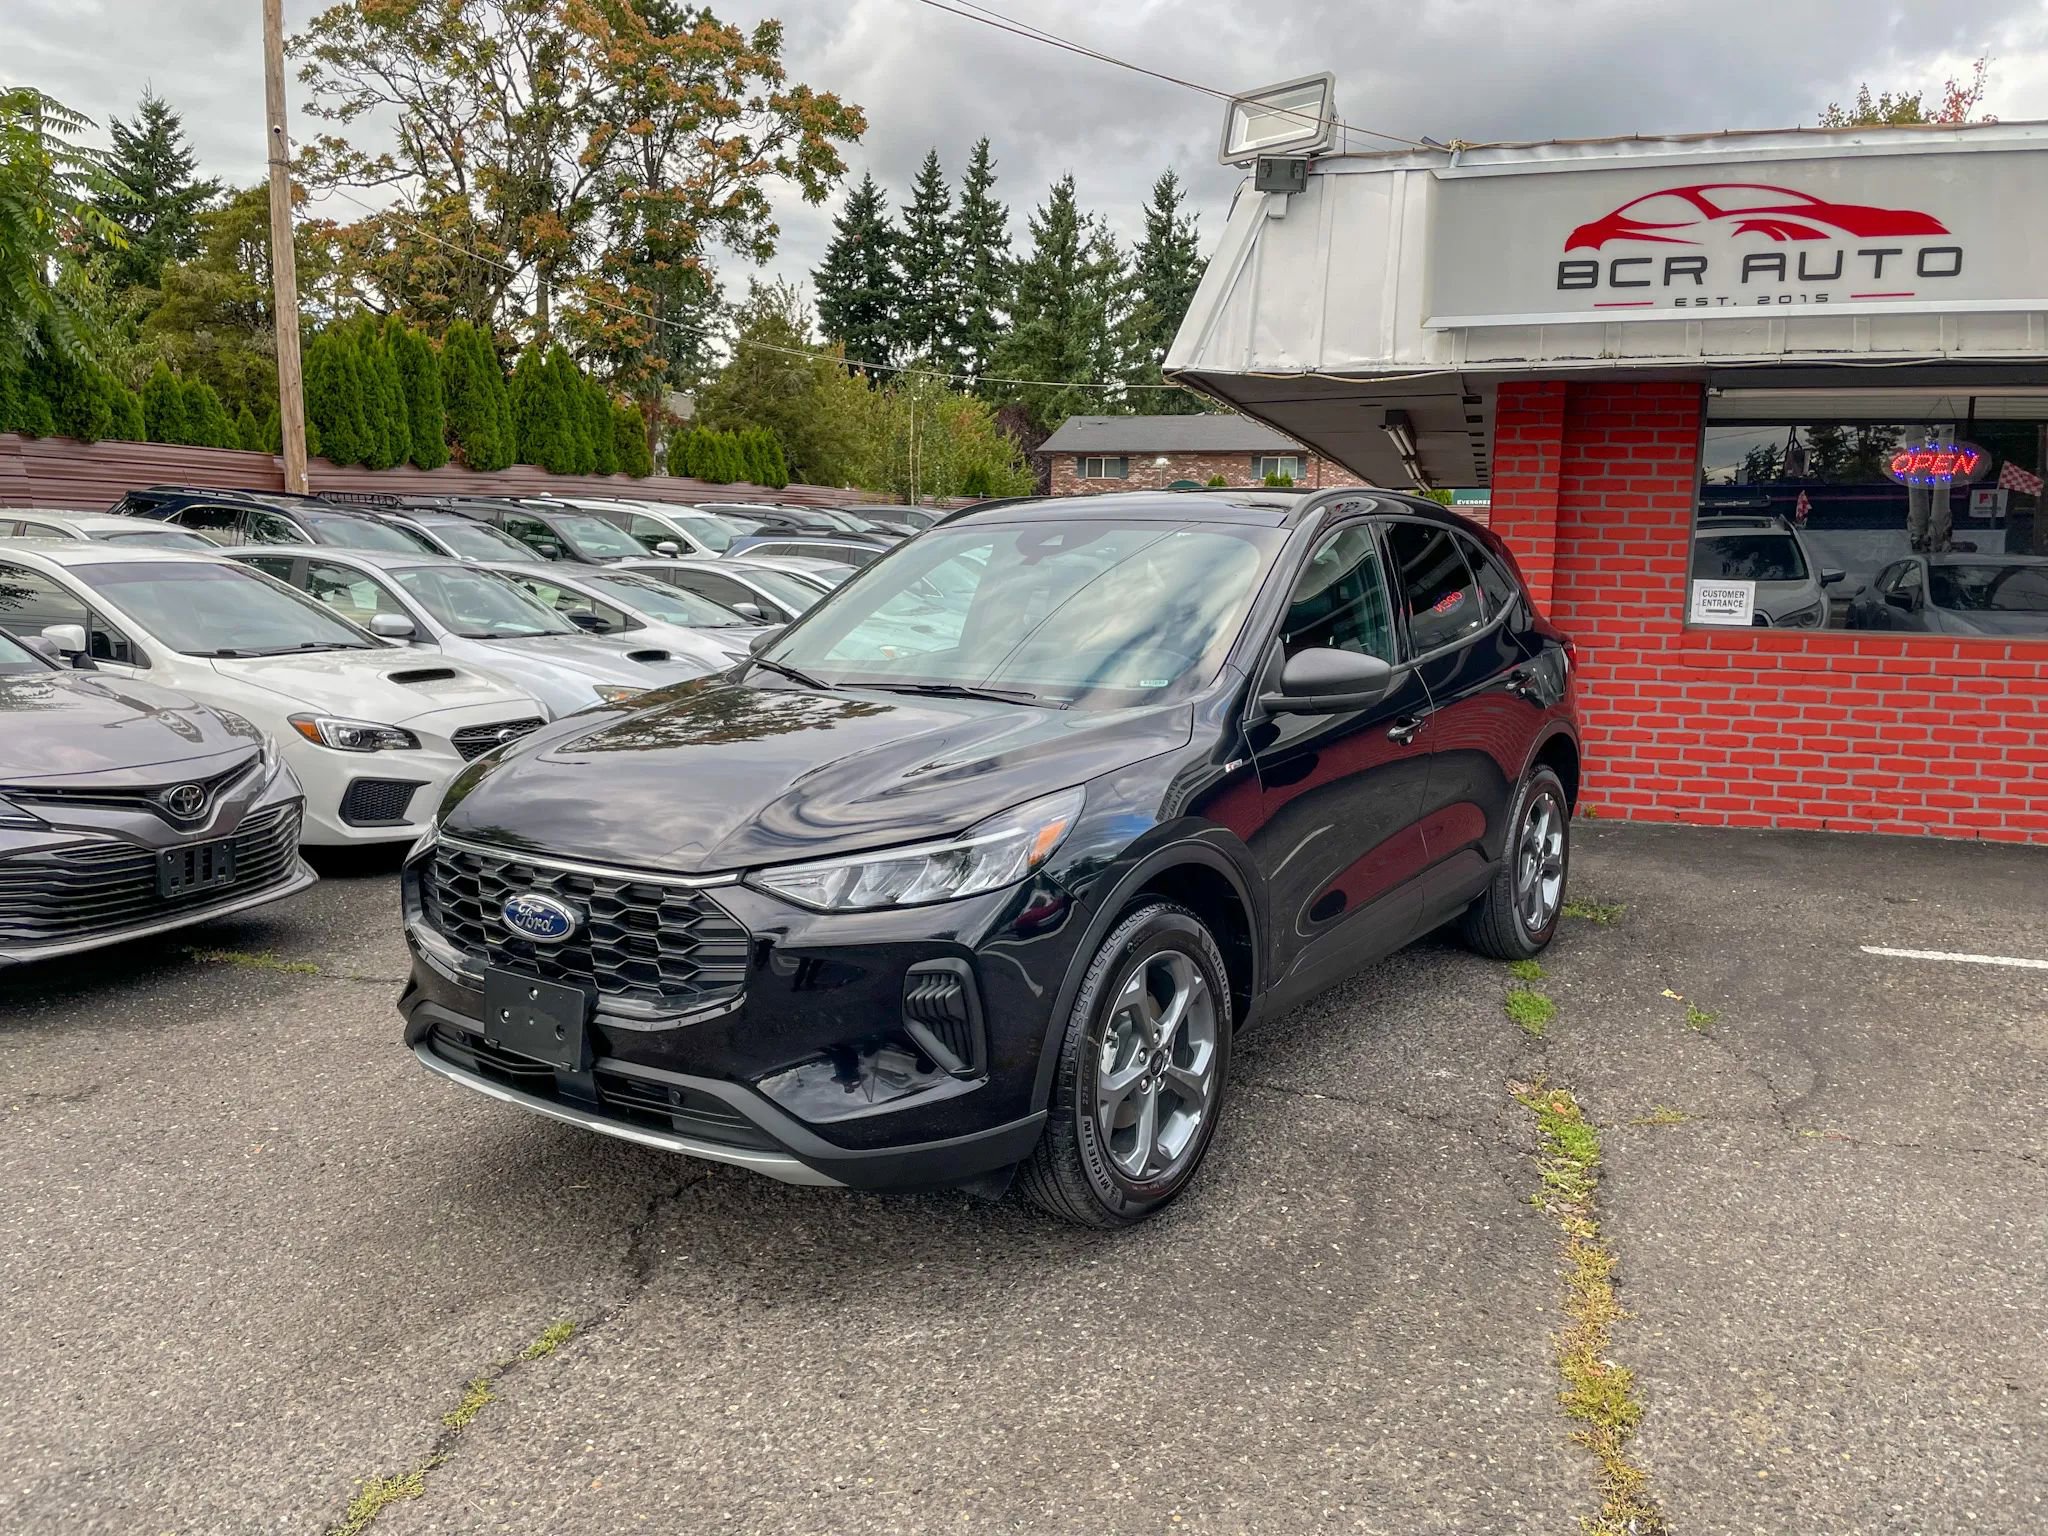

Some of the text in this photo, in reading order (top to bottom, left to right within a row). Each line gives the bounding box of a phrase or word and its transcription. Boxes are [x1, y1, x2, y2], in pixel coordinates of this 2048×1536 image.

[1557, 247, 1963, 290] BCR AUTO
[1674, 294, 1829, 307] EST. 2015
[1891, 453, 1979, 475] OPEN
[1702, 590, 1745, 599] CUSTOMER
[1702, 599, 1743, 608] ENTRANCE
[515, 903, 555, 932] Ford
[1211, 950, 1231, 1016] MICHELIN
[1083, 1120, 1110, 1191] MICHELIN
